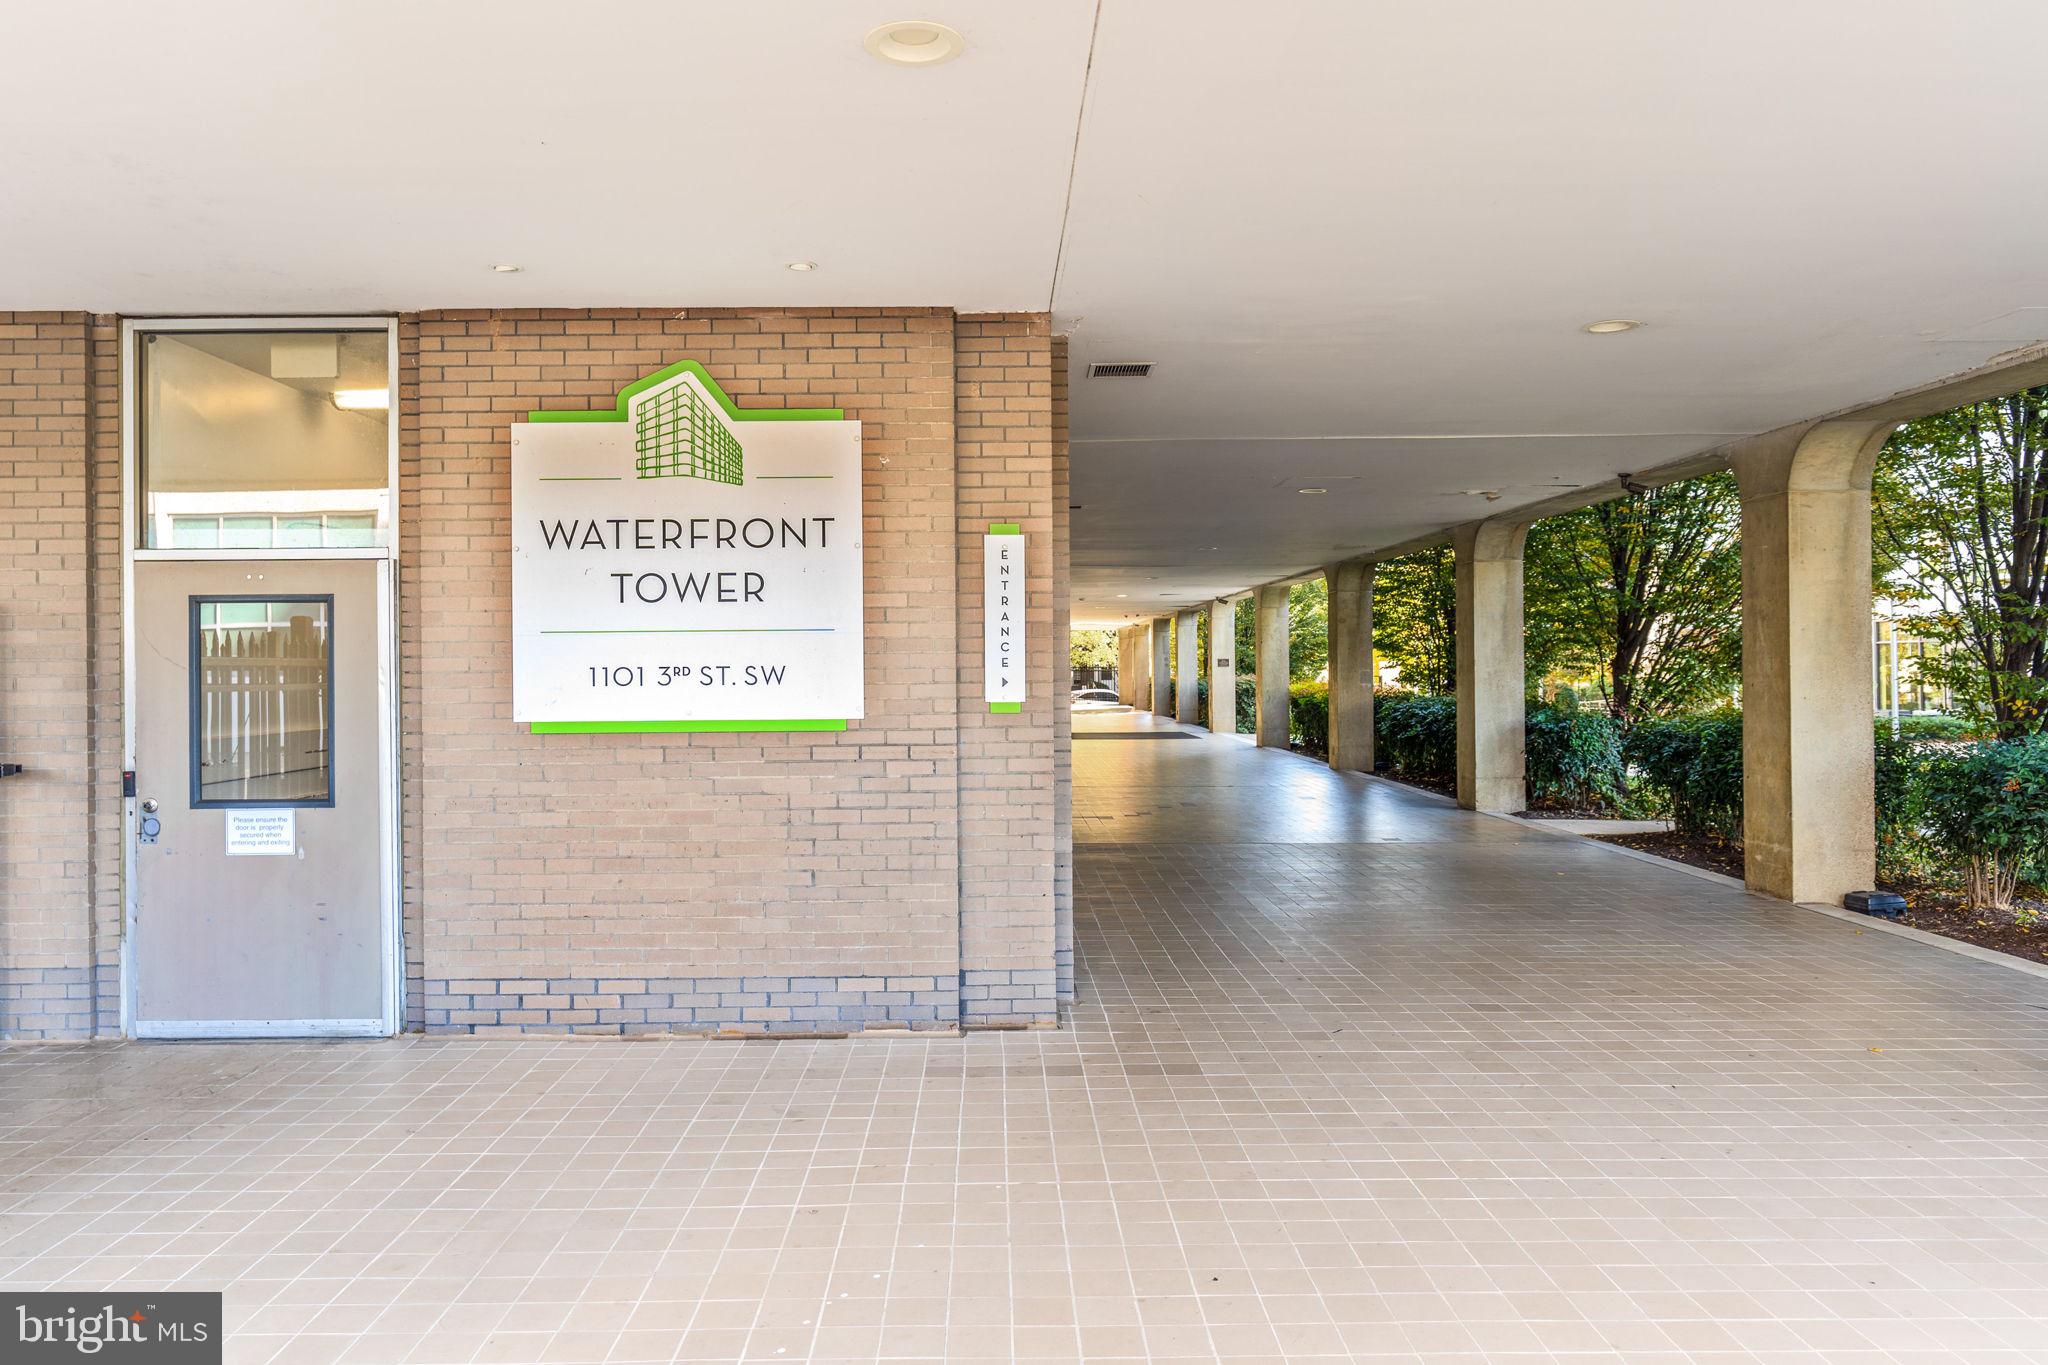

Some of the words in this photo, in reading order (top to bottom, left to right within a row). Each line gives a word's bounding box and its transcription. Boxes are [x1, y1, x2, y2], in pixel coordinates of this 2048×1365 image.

[539, 517, 836, 550] WATERFRONT
[610, 571, 766, 603] TOWER
[1000, 549, 1010, 668] ENTRANCE
[589, 666, 645, 687] 1101
[656, 665, 691, 687] 3RD
[699, 665, 737, 686] ST.
[744, 664, 787, 686] SW
